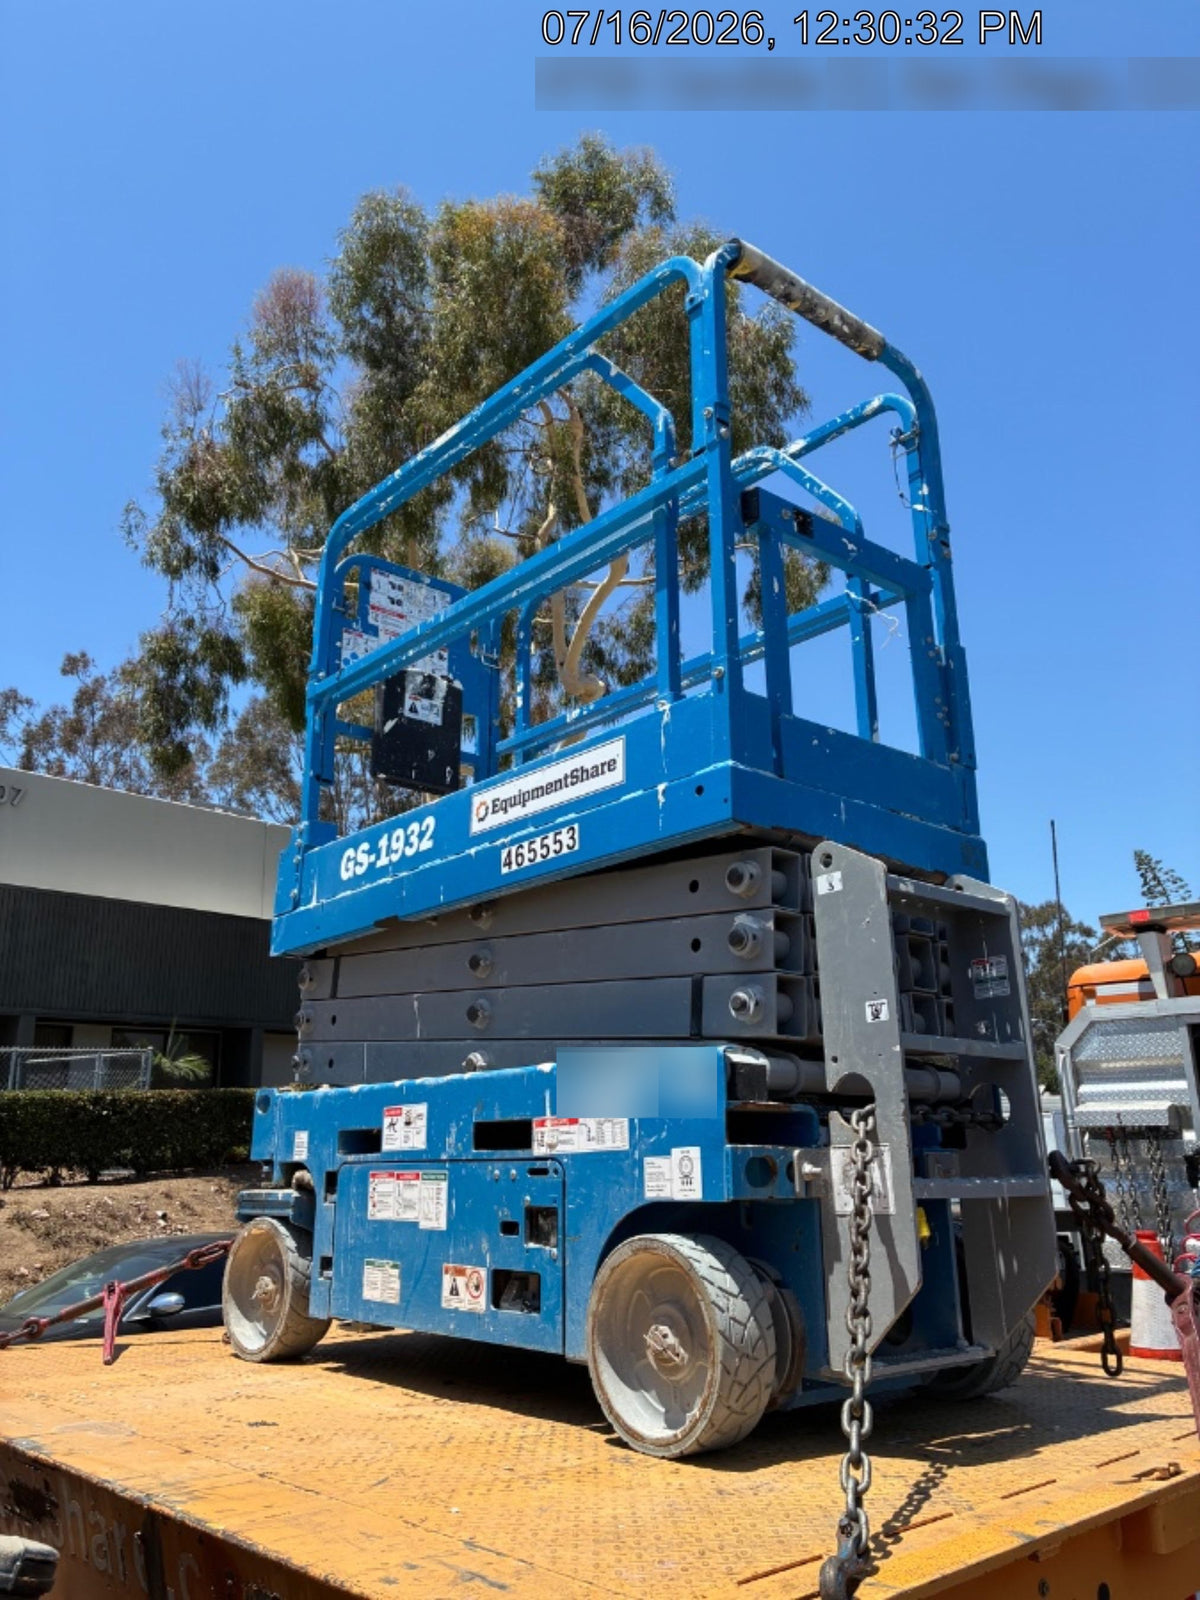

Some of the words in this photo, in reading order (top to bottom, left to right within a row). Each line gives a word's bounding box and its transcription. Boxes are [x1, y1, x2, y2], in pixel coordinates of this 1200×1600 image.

[490, 756, 618, 816] EquipmentShare
[340, 815, 436, 881] GS-1932
[502, 826, 577, 871] 465553
